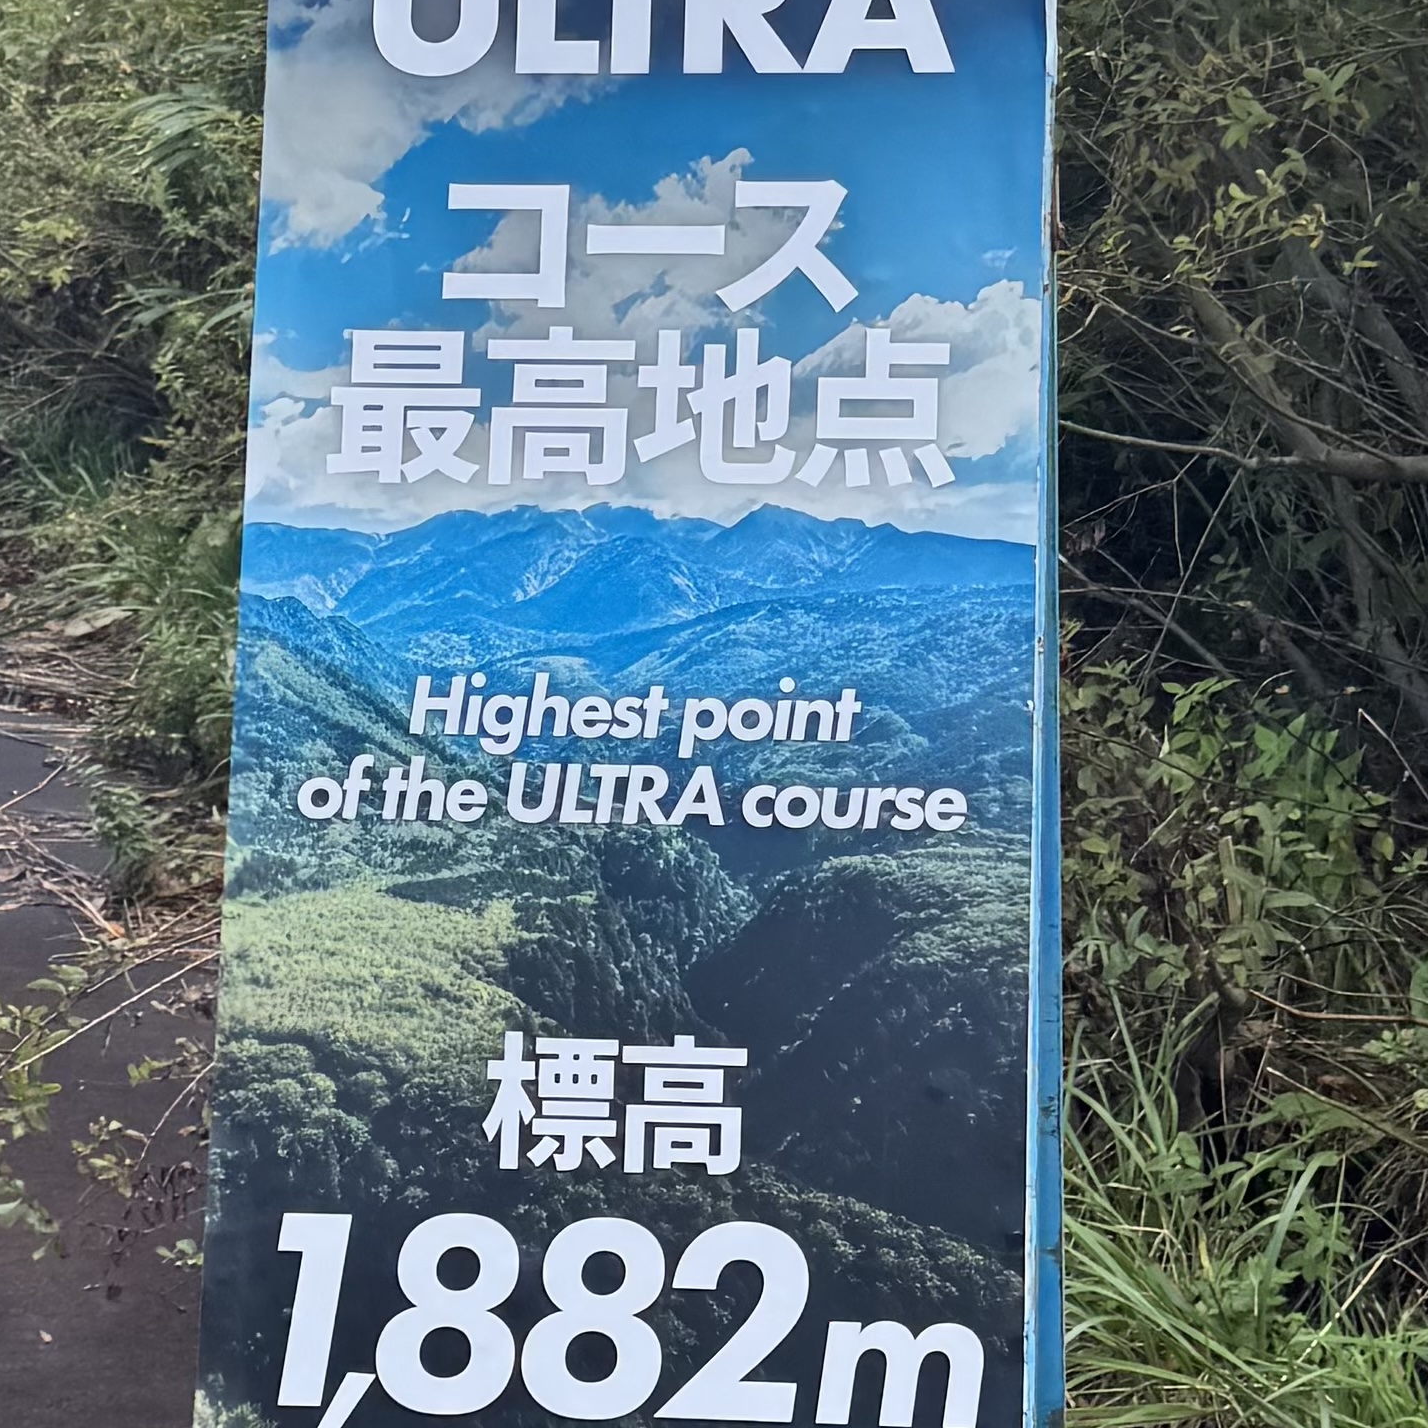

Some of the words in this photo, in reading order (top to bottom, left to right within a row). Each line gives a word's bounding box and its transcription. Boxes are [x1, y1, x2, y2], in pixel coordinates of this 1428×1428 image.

[441, 179, 858, 313] コース
[326, 326, 956, 488] 最高地点
[409, 673, 668, 756] Highest
[678, 675, 862, 758] point
[296, 756, 379, 824] of
[382, 758, 488, 822] the
[506, 764, 726, 828] ULTRA
[739, 777, 969, 833] course
[482, 1030, 748, 1175] 標高
